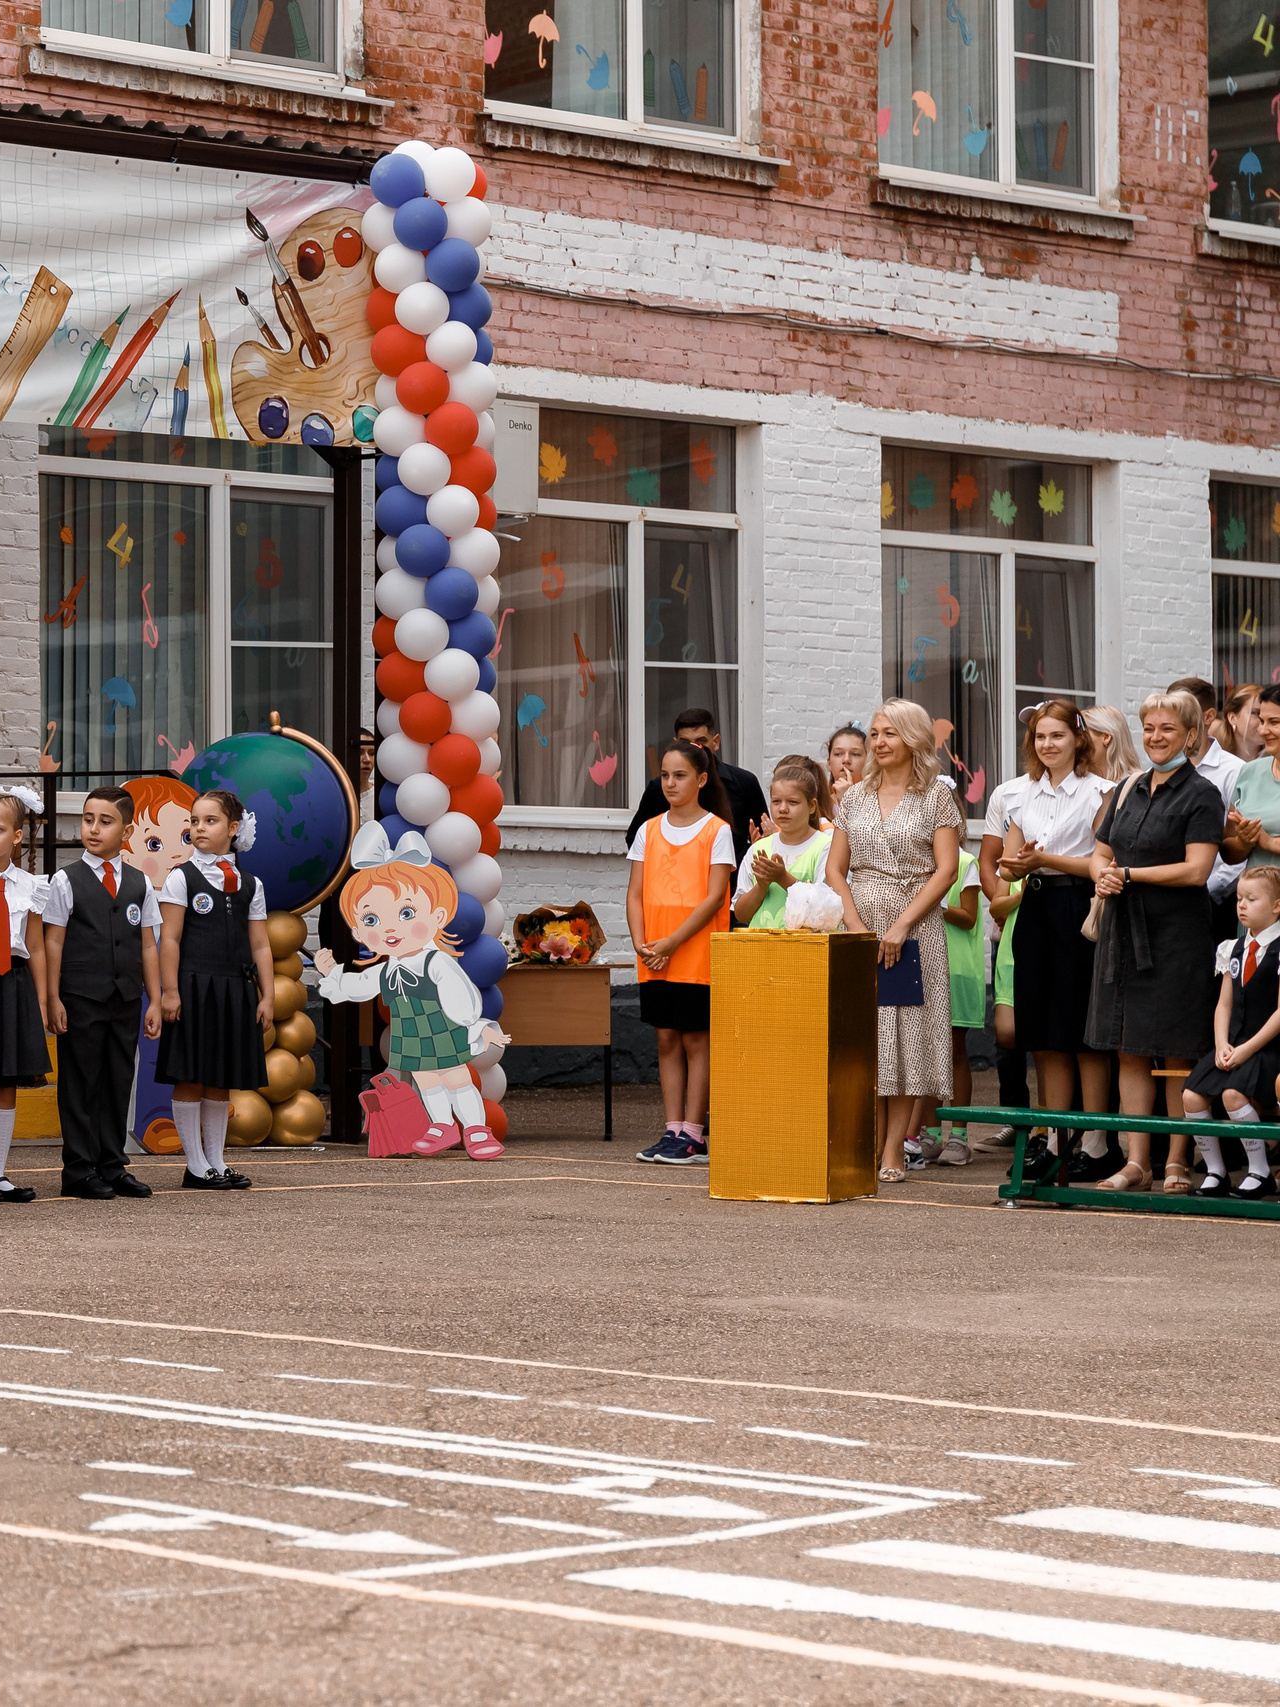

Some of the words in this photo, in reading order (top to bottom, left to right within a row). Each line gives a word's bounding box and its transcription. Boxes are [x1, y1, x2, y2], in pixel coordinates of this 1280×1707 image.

[1252, 13, 1275, 57] 4
[508, 419, 533, 431] Denko
[106, 522, 134, 569] 4
[541, 551, 566, 600] 5
[936, 584, 961, 628] 5
[1239, 608, 1258, 645] 4
